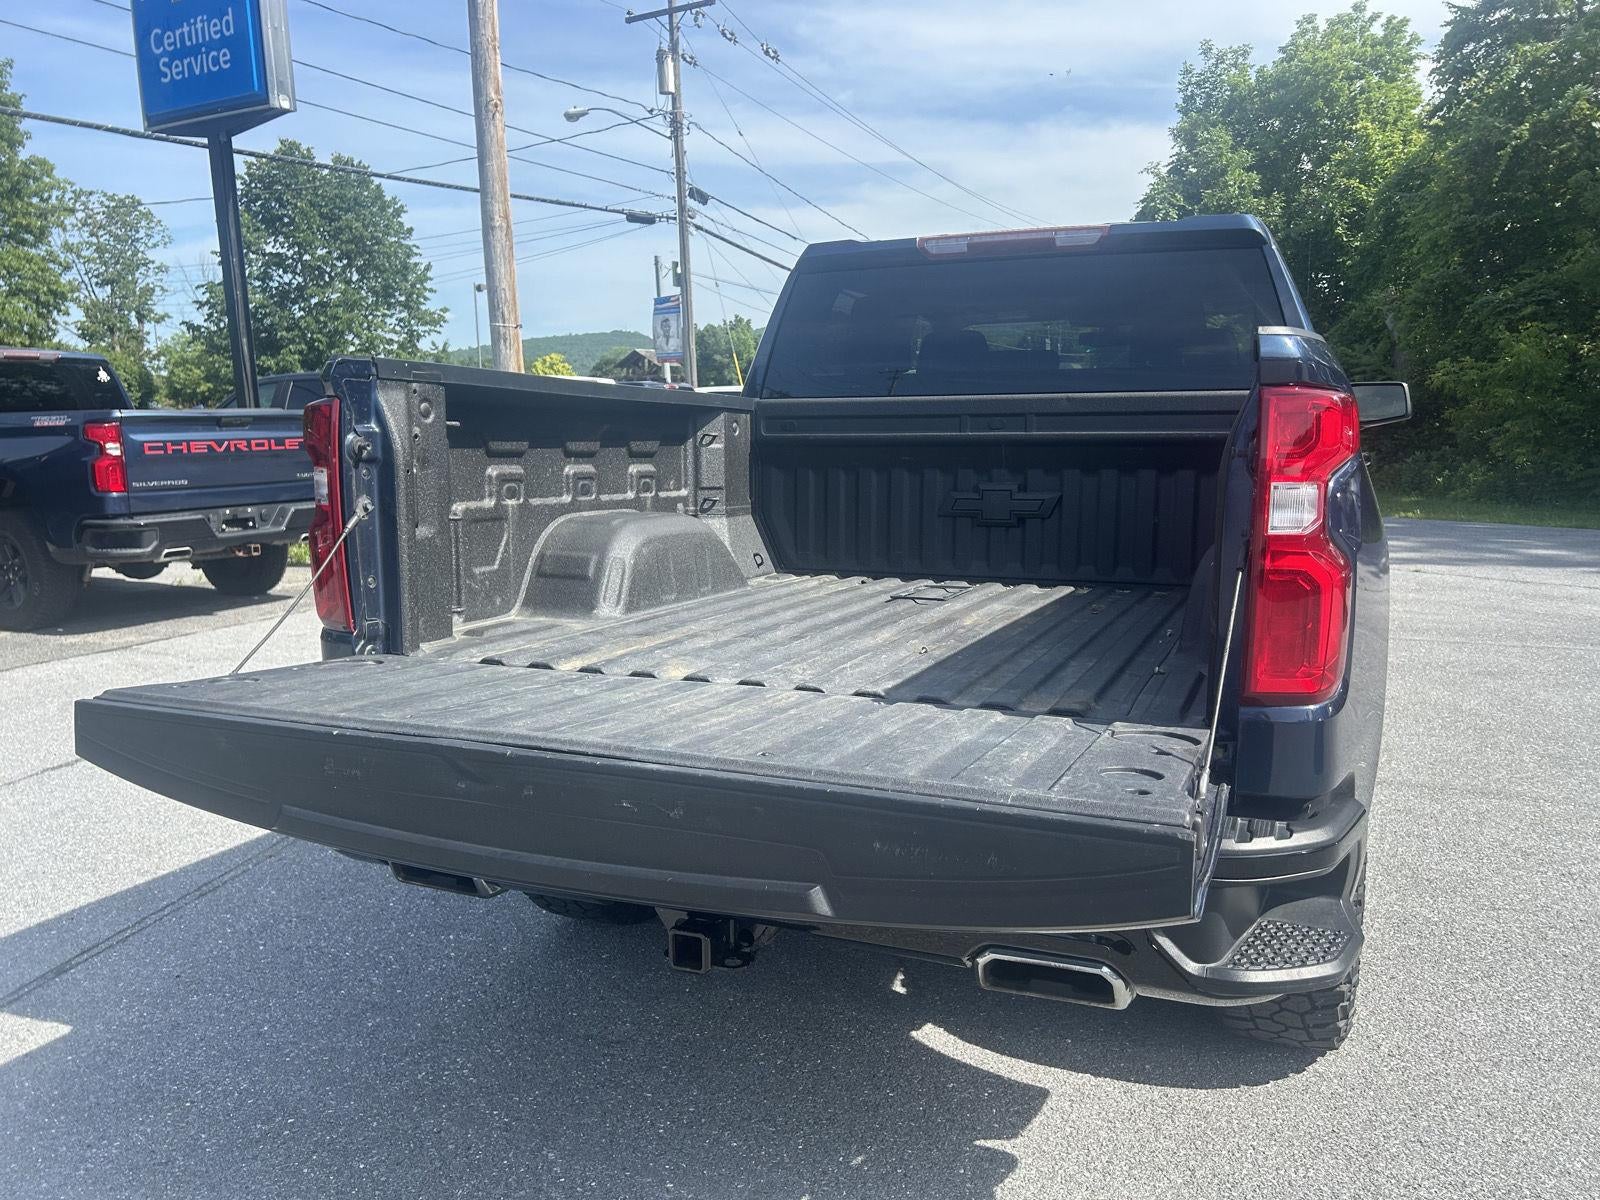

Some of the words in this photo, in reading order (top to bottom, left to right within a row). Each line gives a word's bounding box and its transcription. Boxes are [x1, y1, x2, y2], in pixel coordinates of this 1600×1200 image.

[150, 7, 234, 54] Certified
[159, 47, 231, 83] Service
[143, 438, 304, 455] CHEVROLE
